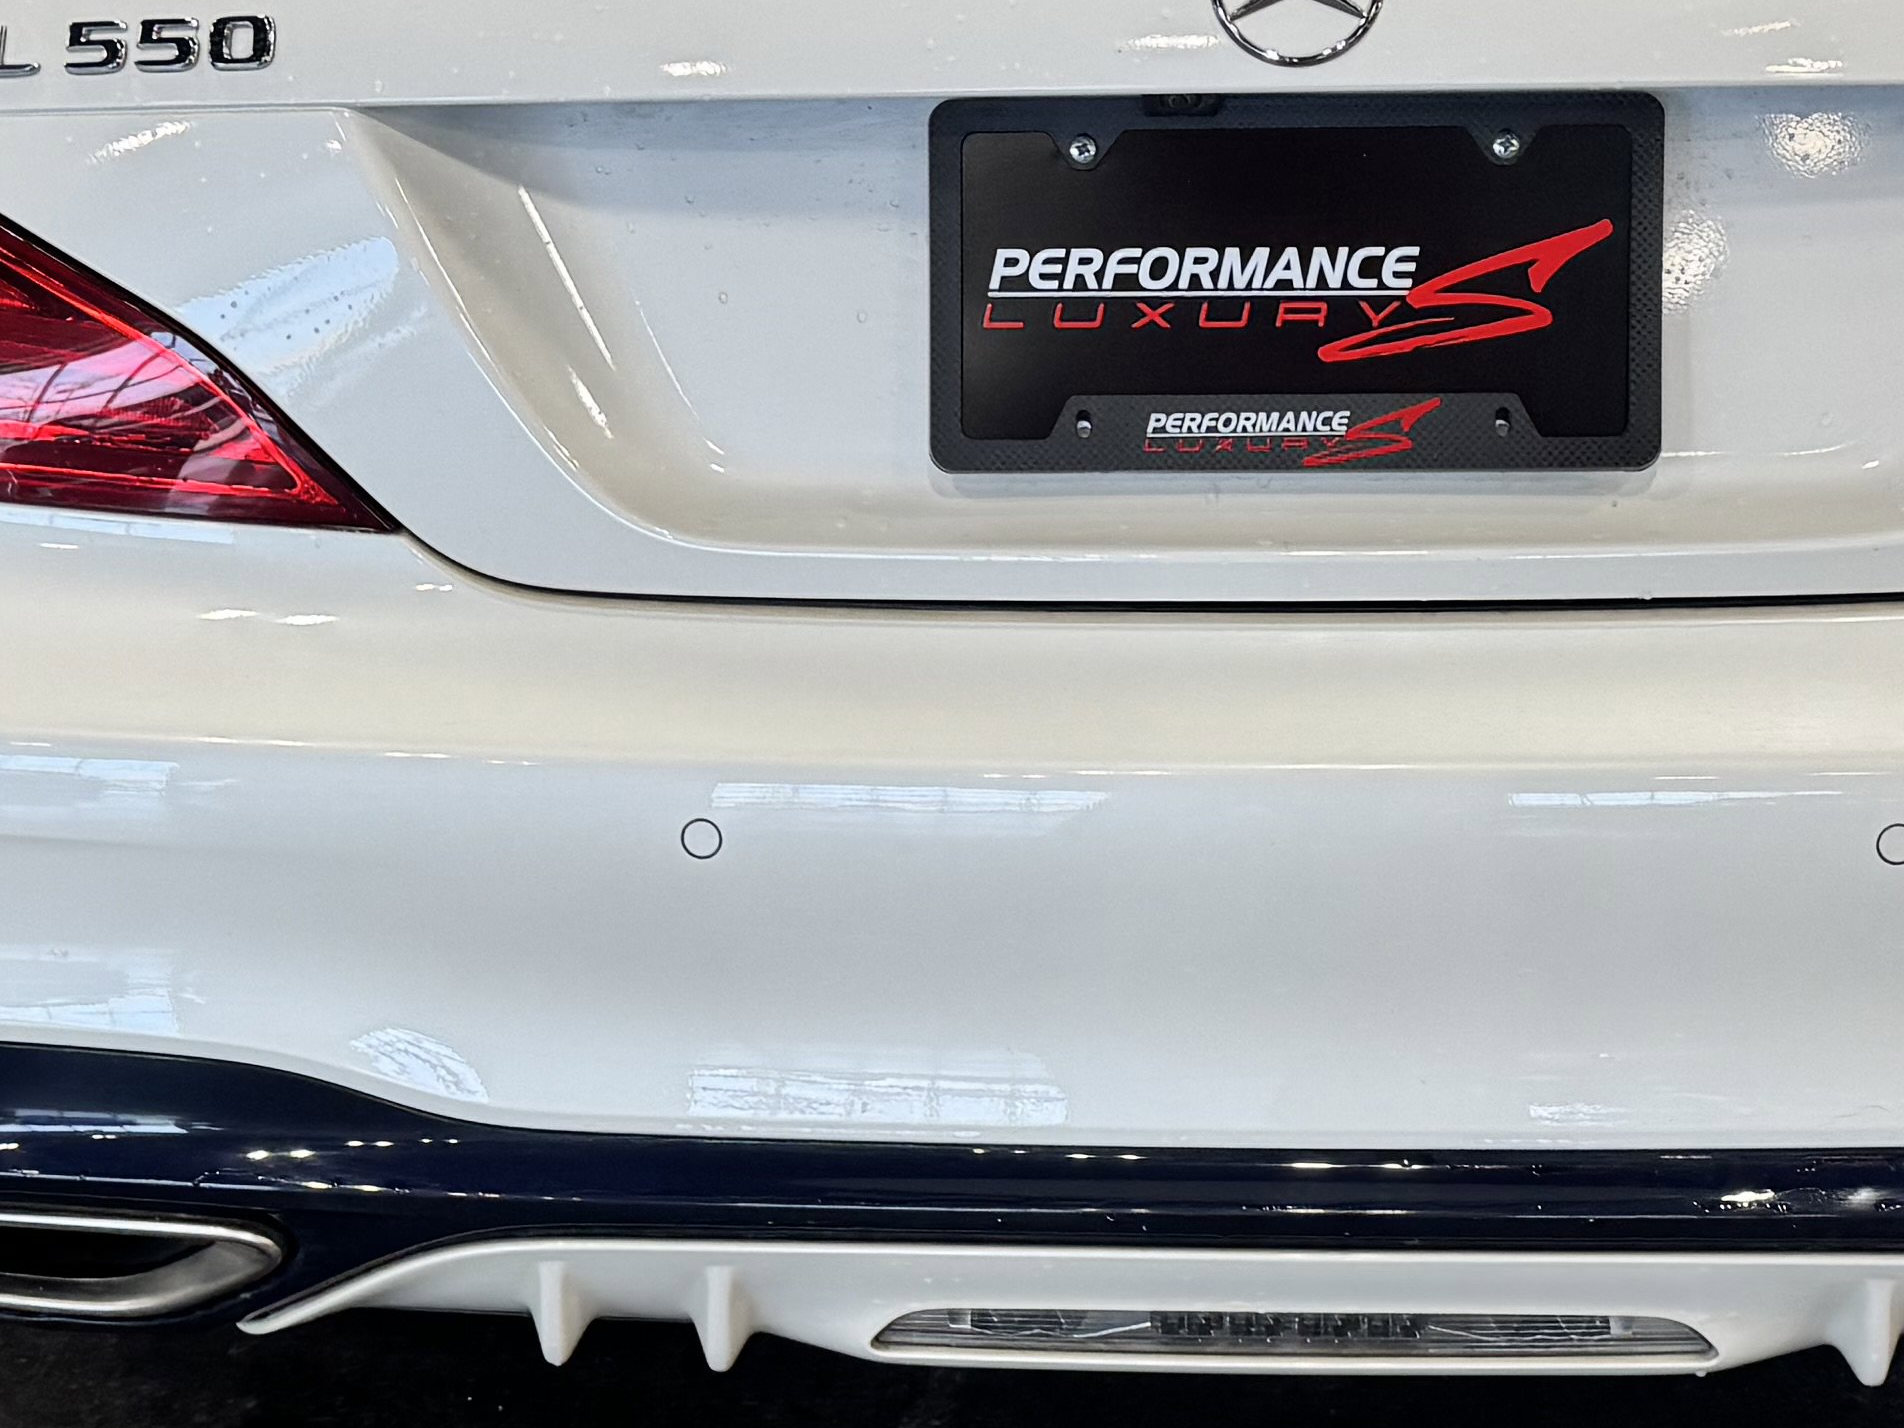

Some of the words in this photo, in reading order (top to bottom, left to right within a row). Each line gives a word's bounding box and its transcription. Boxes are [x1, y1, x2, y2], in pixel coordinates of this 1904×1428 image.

[63, 14, 277, 76] 550
[987, 245, 1421, 291] PERFORMANCE
[982, 300, 1402, 330] LUXURY
[1146, 410, 1351, 435] PERFORMANCE
[1143, 437, 1342, 453] LUXURY
